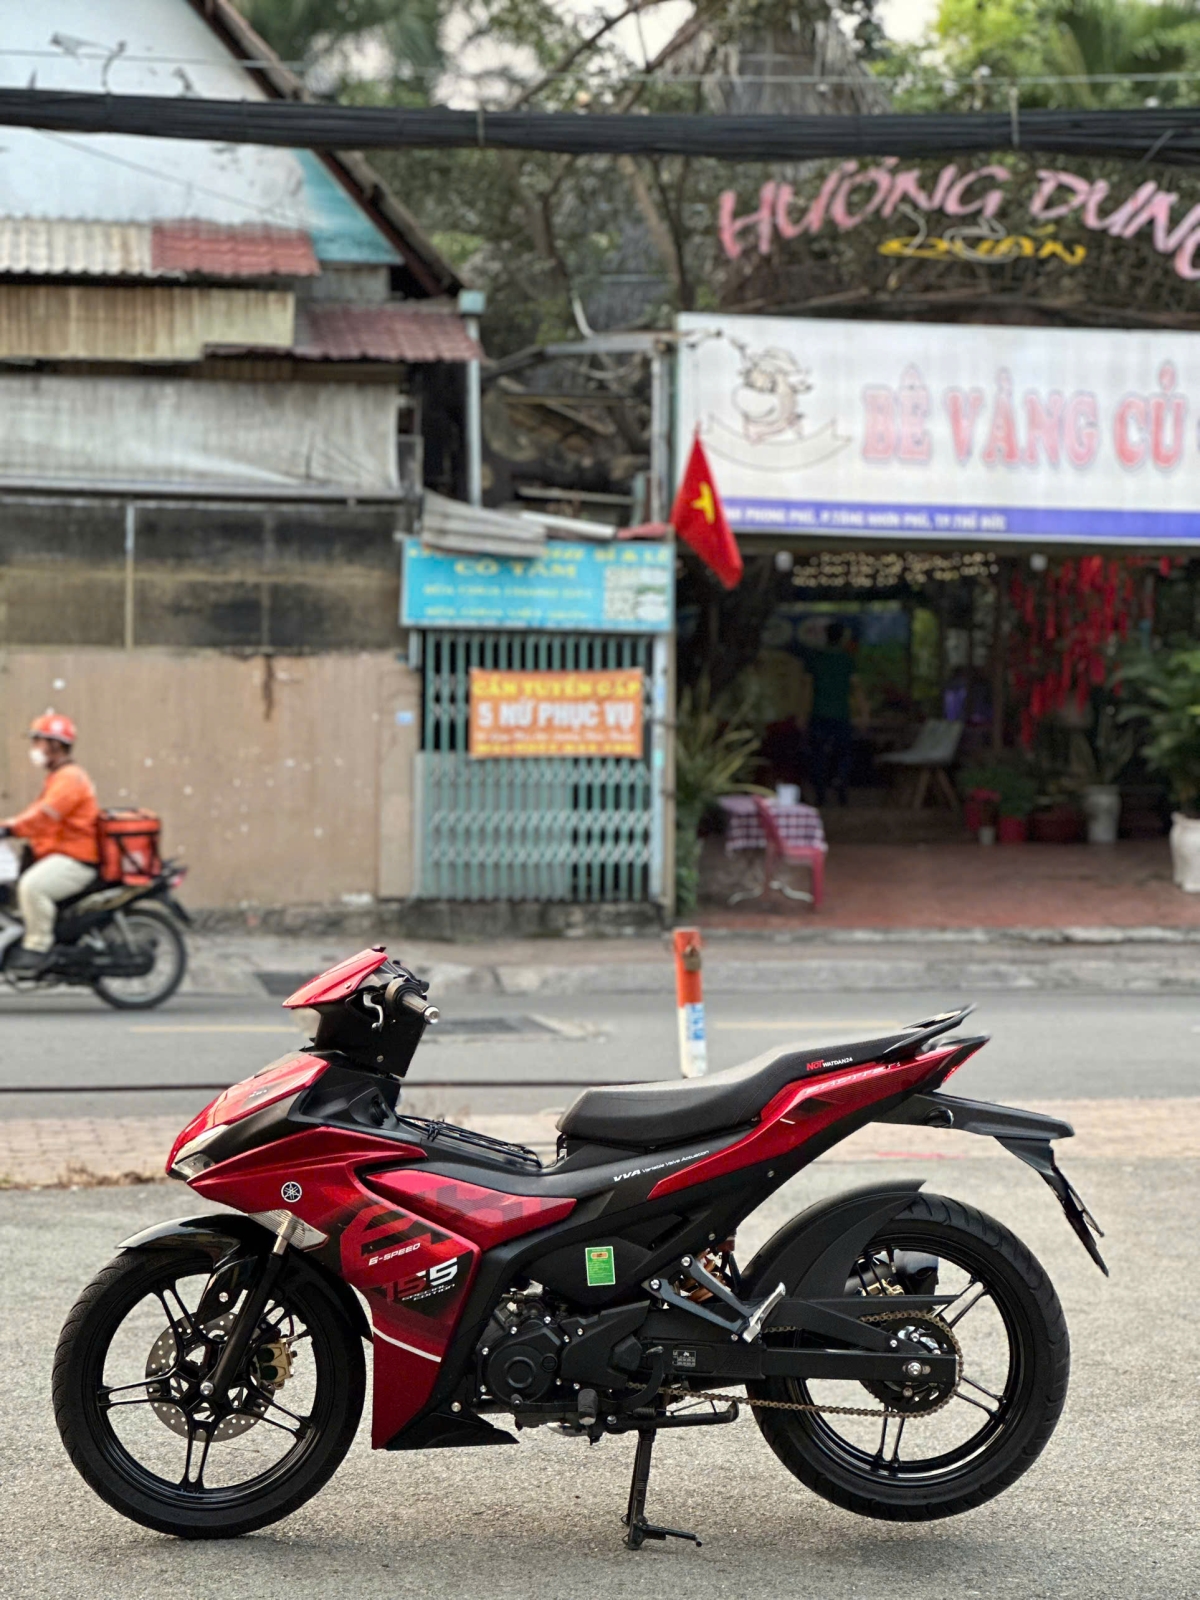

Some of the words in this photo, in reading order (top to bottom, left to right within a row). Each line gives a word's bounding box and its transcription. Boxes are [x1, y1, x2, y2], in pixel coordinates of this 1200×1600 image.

[1113, 358, 1190, 474] CỦ
[537, 701, 599, 732] PHỤC
[603, 701, 635, 732] VỤ
[612, 1169, 642, 1182] VVA
[368, 1242, 421, 1266] 6-SPEED
